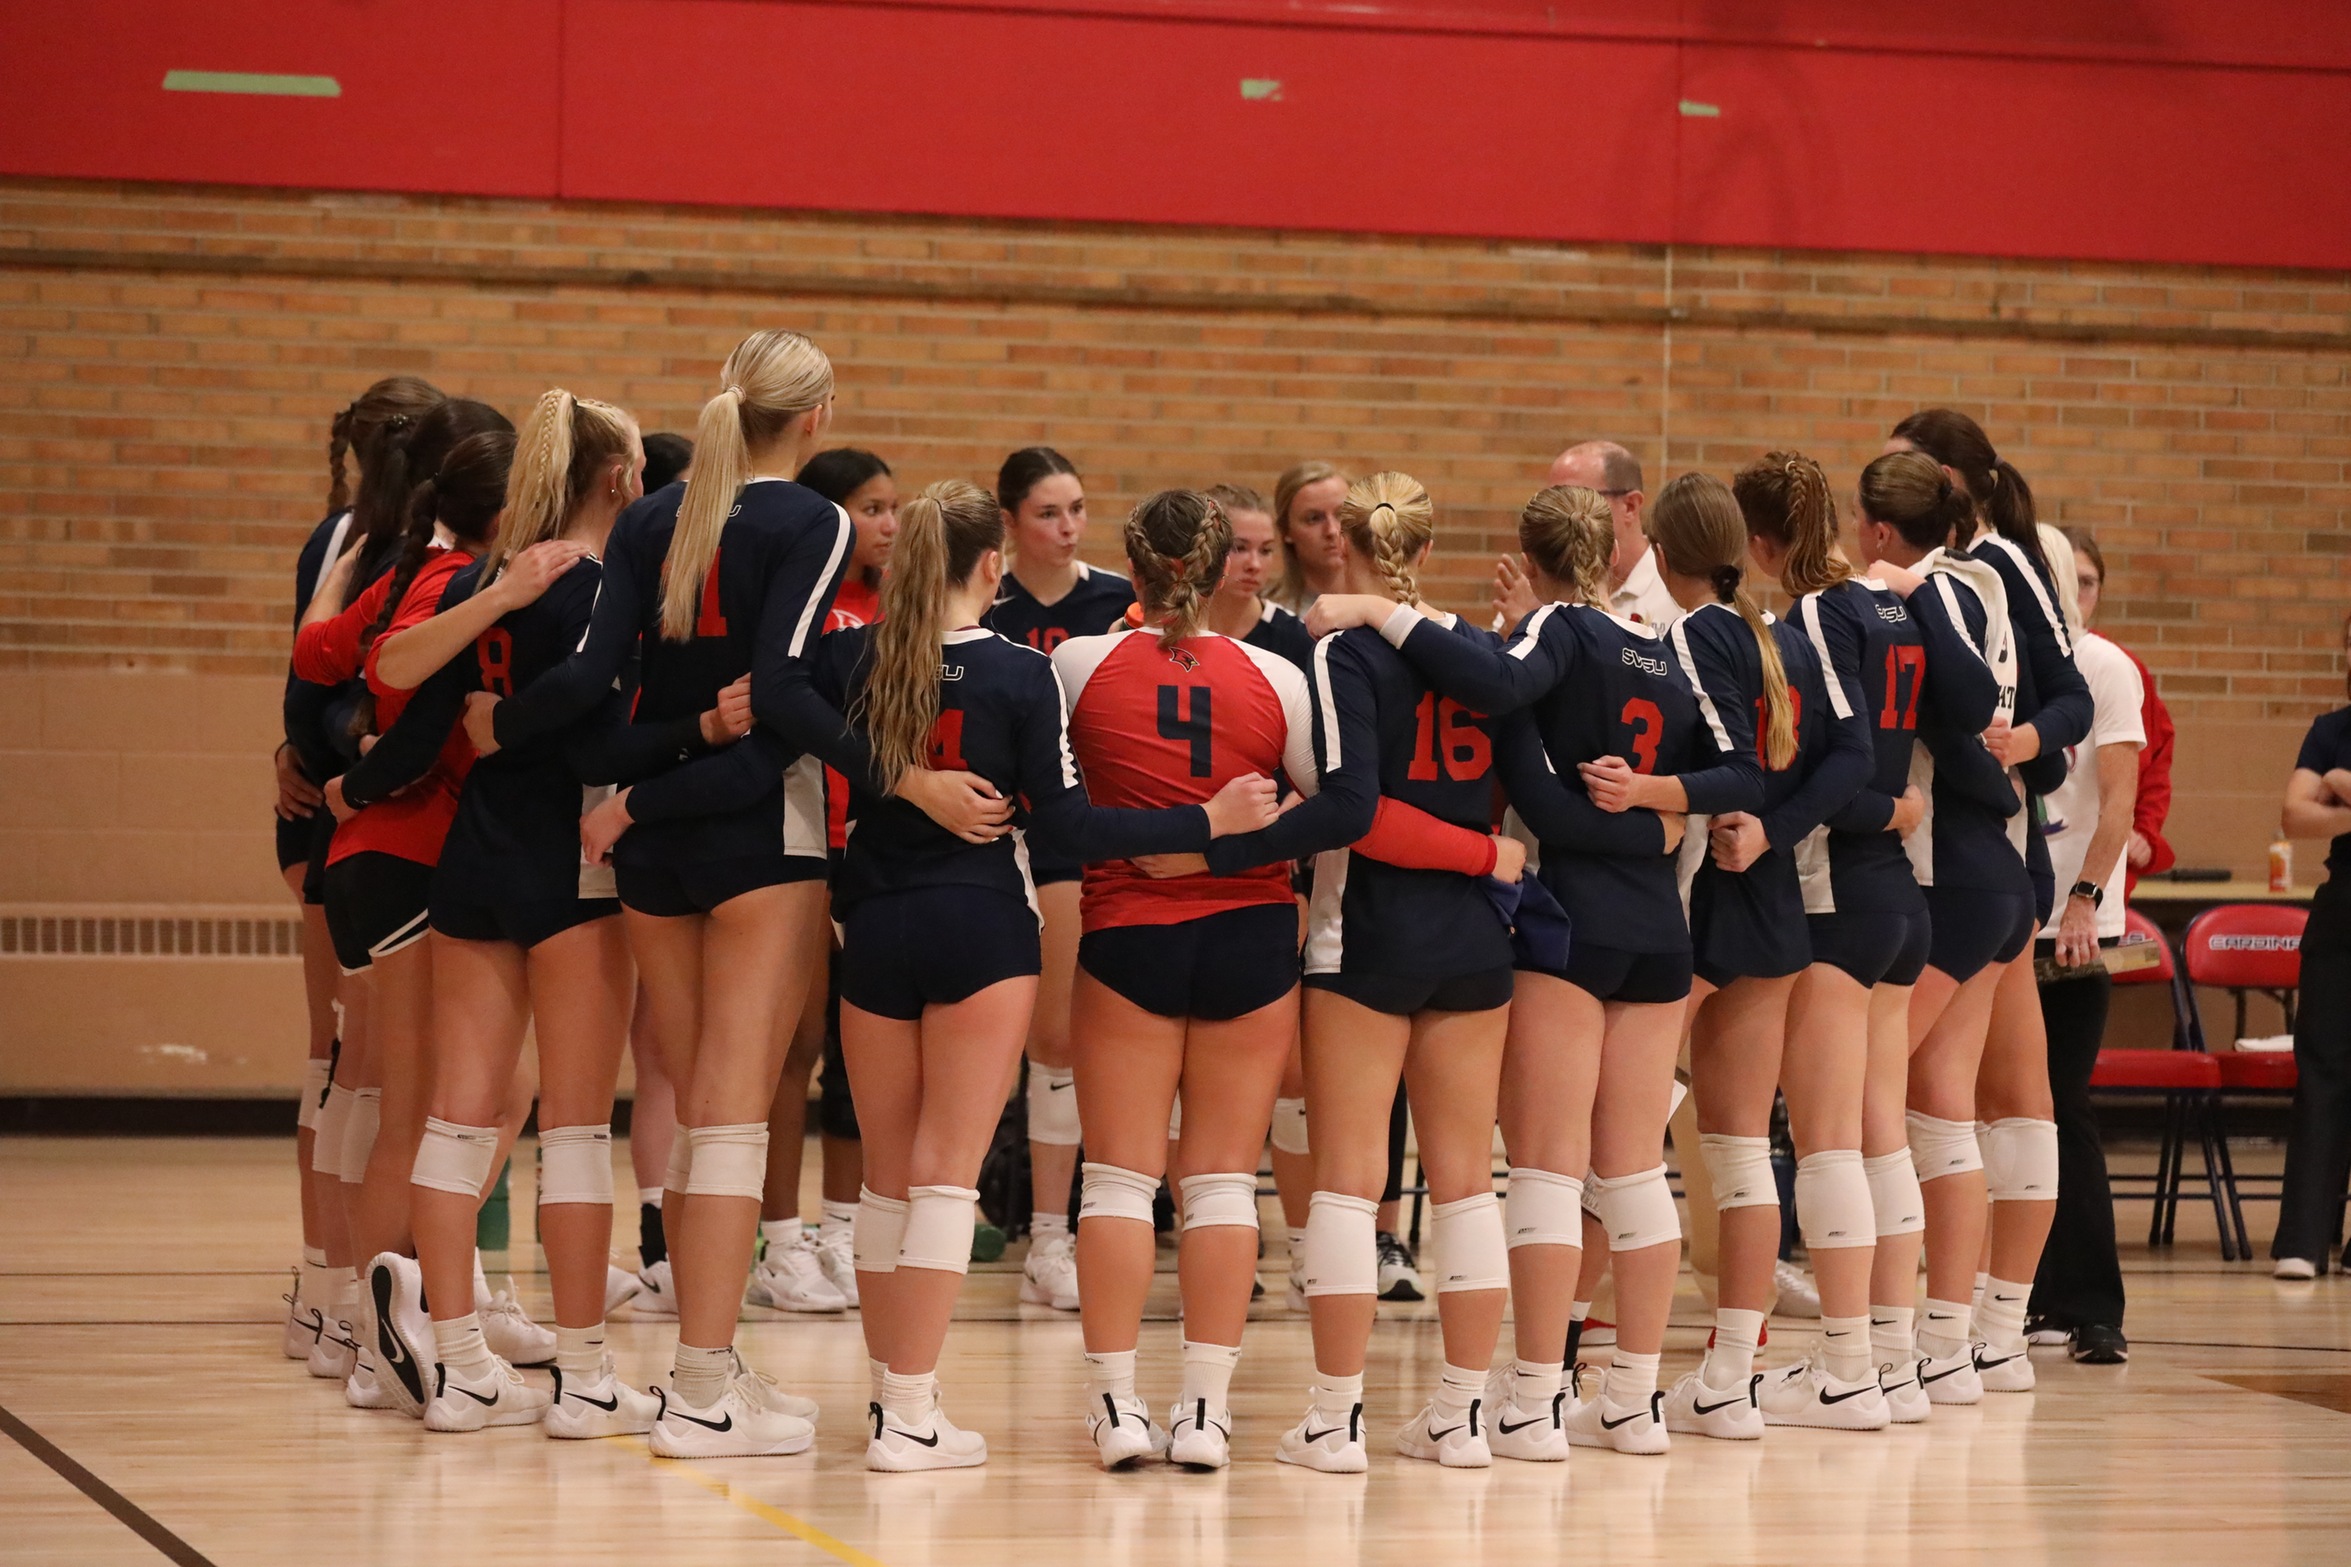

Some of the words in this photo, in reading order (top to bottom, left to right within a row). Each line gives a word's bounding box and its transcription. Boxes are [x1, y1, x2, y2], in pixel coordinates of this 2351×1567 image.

[477, 627, 513, 696] 8
[1622, 647, 1668, 676] SVSU
[1880, 643, 1926, 729] 17
[1157, 685, 1212, 777] 4
[1407, 690, 1493, 782] 16
[1621, 697, 1664, 775] 3
[2209, 935, 2301, 950] CARDINA
